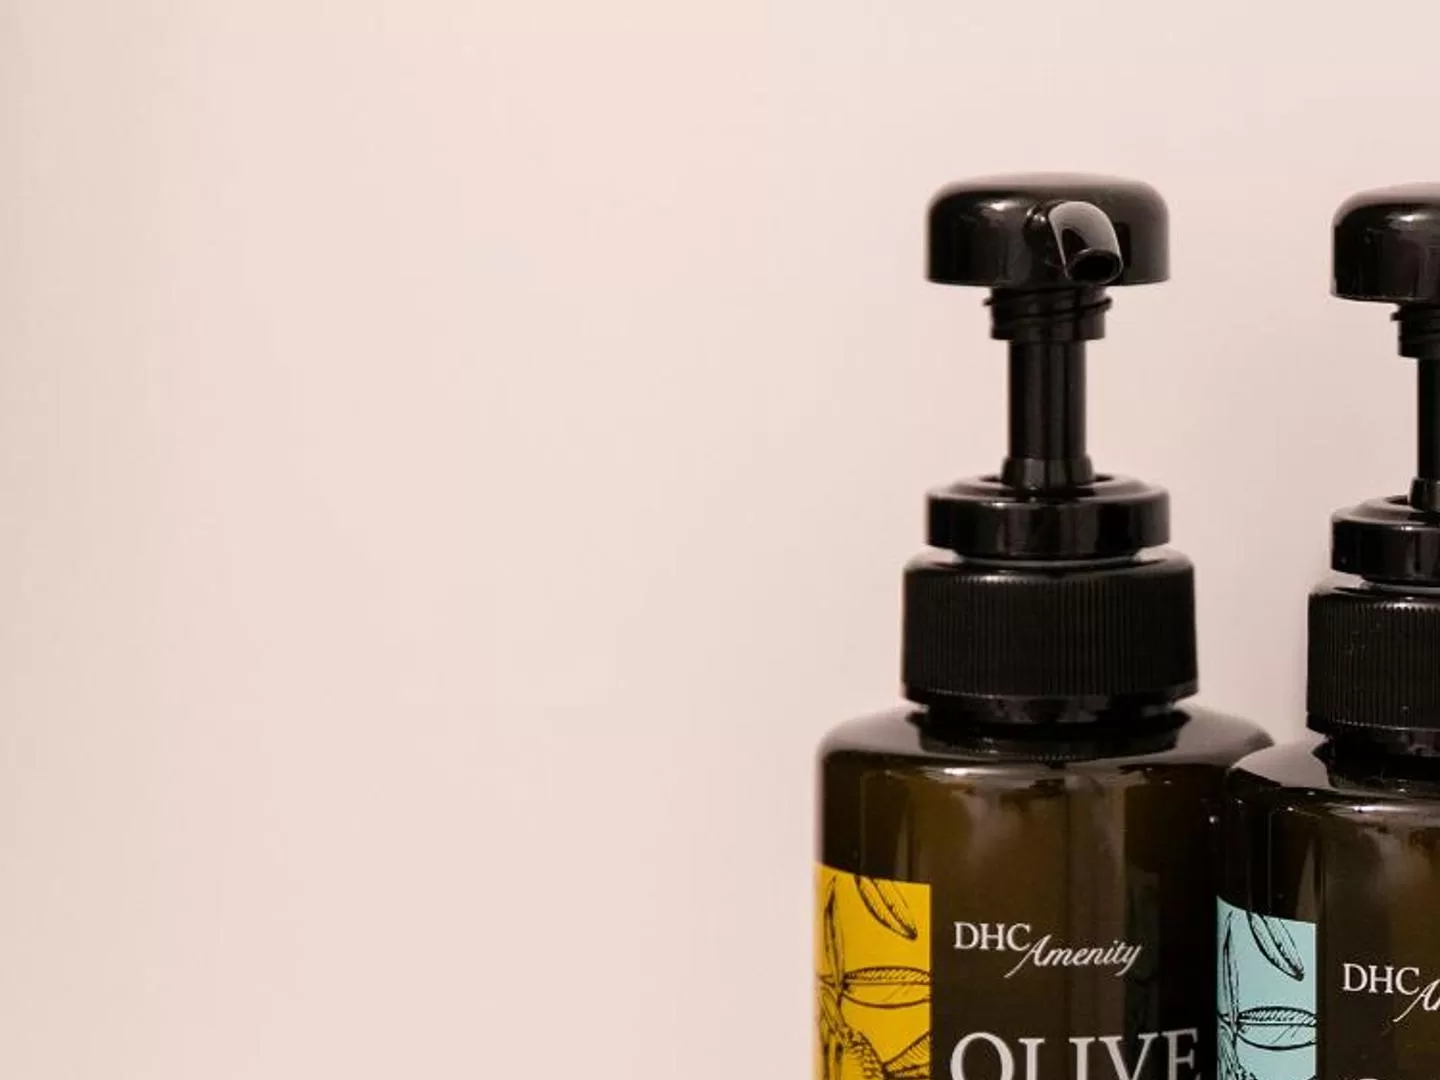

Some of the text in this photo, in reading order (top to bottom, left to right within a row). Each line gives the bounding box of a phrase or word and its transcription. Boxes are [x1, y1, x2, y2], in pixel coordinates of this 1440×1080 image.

[954, 921, 1143, 979] DHC Amenity
[1342, 963, 1421, 996] DHC
